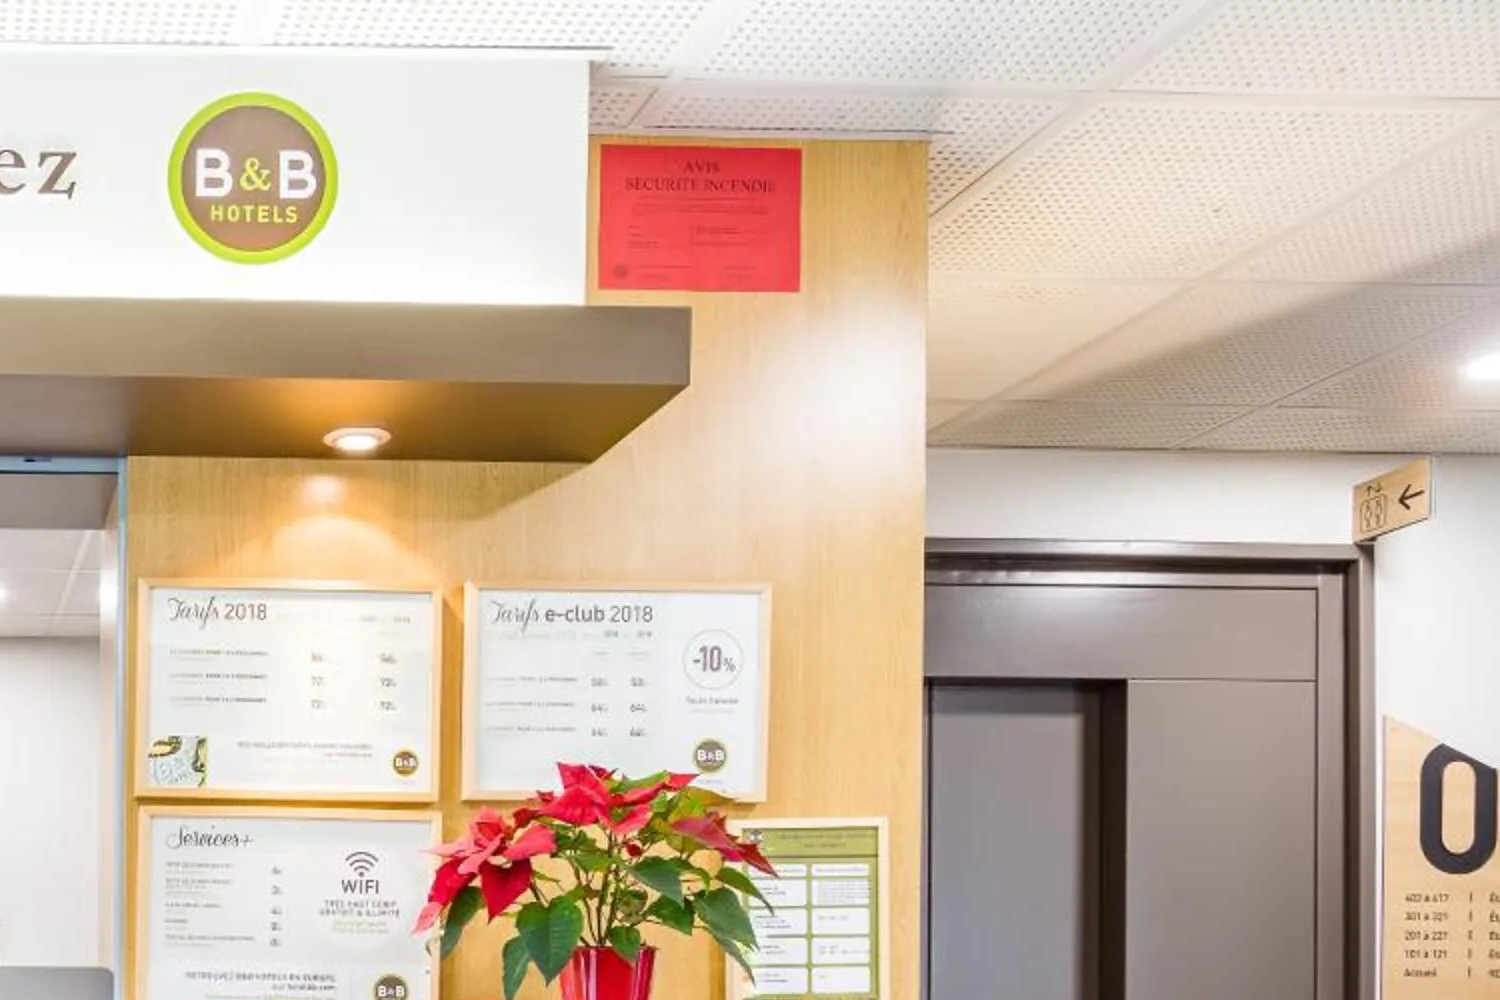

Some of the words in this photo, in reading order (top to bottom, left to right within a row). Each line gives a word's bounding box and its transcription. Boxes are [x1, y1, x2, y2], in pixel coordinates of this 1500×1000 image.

[194, 148, 317, 198] B&B
[683, 159, 721, 174] AVIS
[210, 203, 299, 224] HOTELS
[168, 596, 220, 630] Tarifs
[224, 603, 267, 621] 2018
[490, 598, 539, 632] Tarifs
[545, 604, 605, 623] e-club
[610, 605, 653, 623] 2018
[692, 645, 736, 673] -10%
[698, 749, 724, 761] B&B
[1420, 743, 1498, 875] 0
[377, 985, 405, 997] B&B
